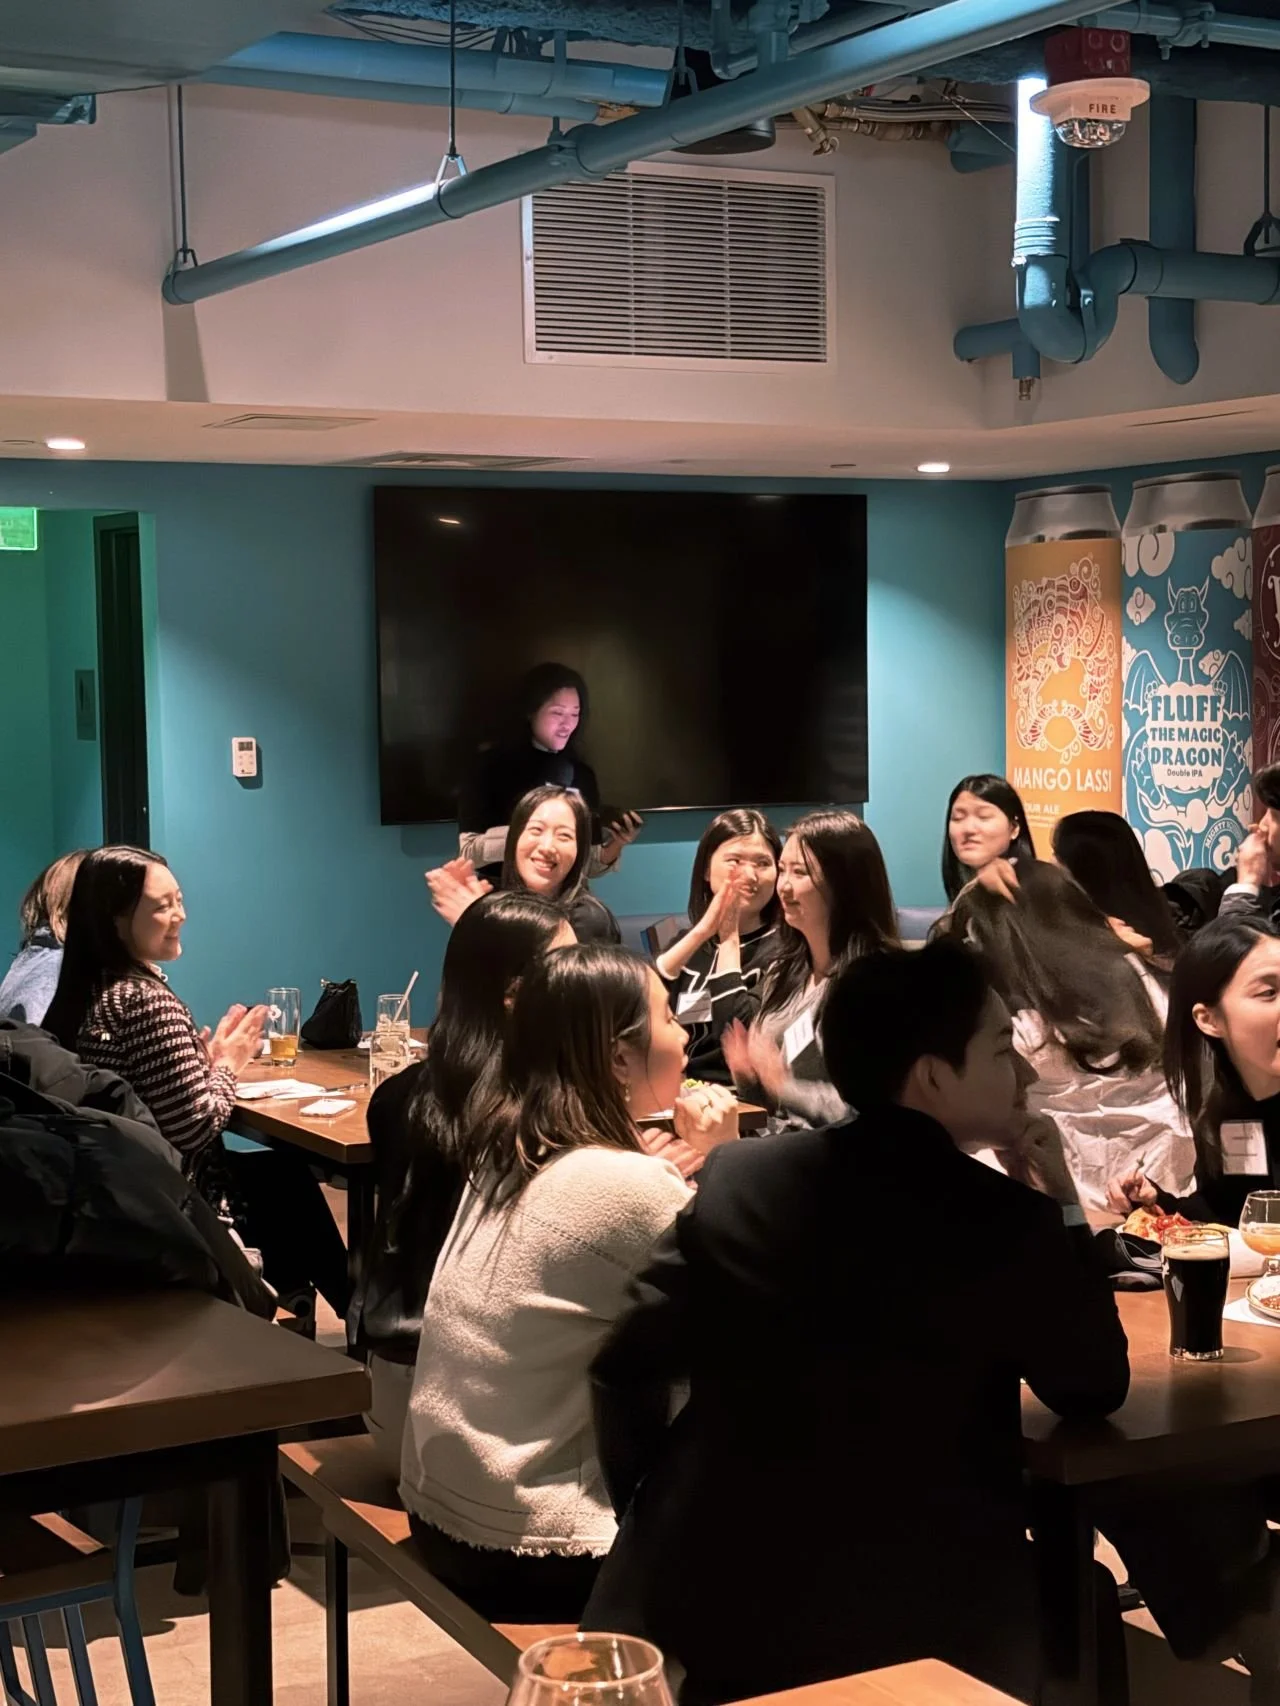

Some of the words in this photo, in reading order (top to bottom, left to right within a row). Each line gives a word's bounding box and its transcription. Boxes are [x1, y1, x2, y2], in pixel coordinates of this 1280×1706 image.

[1088, 103, 1117, 114] FIRE
[1151, 694, 1222, 722] FLUFF
[1150, 727, 1175, 742] THE
[1177, 727, 1221, 743] MAGIC
[1150, 746, 1222, 767] DRAGON
[1013, 767, 1072, 791] MANGO
[1075, 768, 1112, 792] LASSI
[1166, 768, 1190, 777] Double
[1191, 769, 1203, 777] IPA
[1023, 803, 1041, 813] OUR
[1042, 803, 1060, 815] ALE
